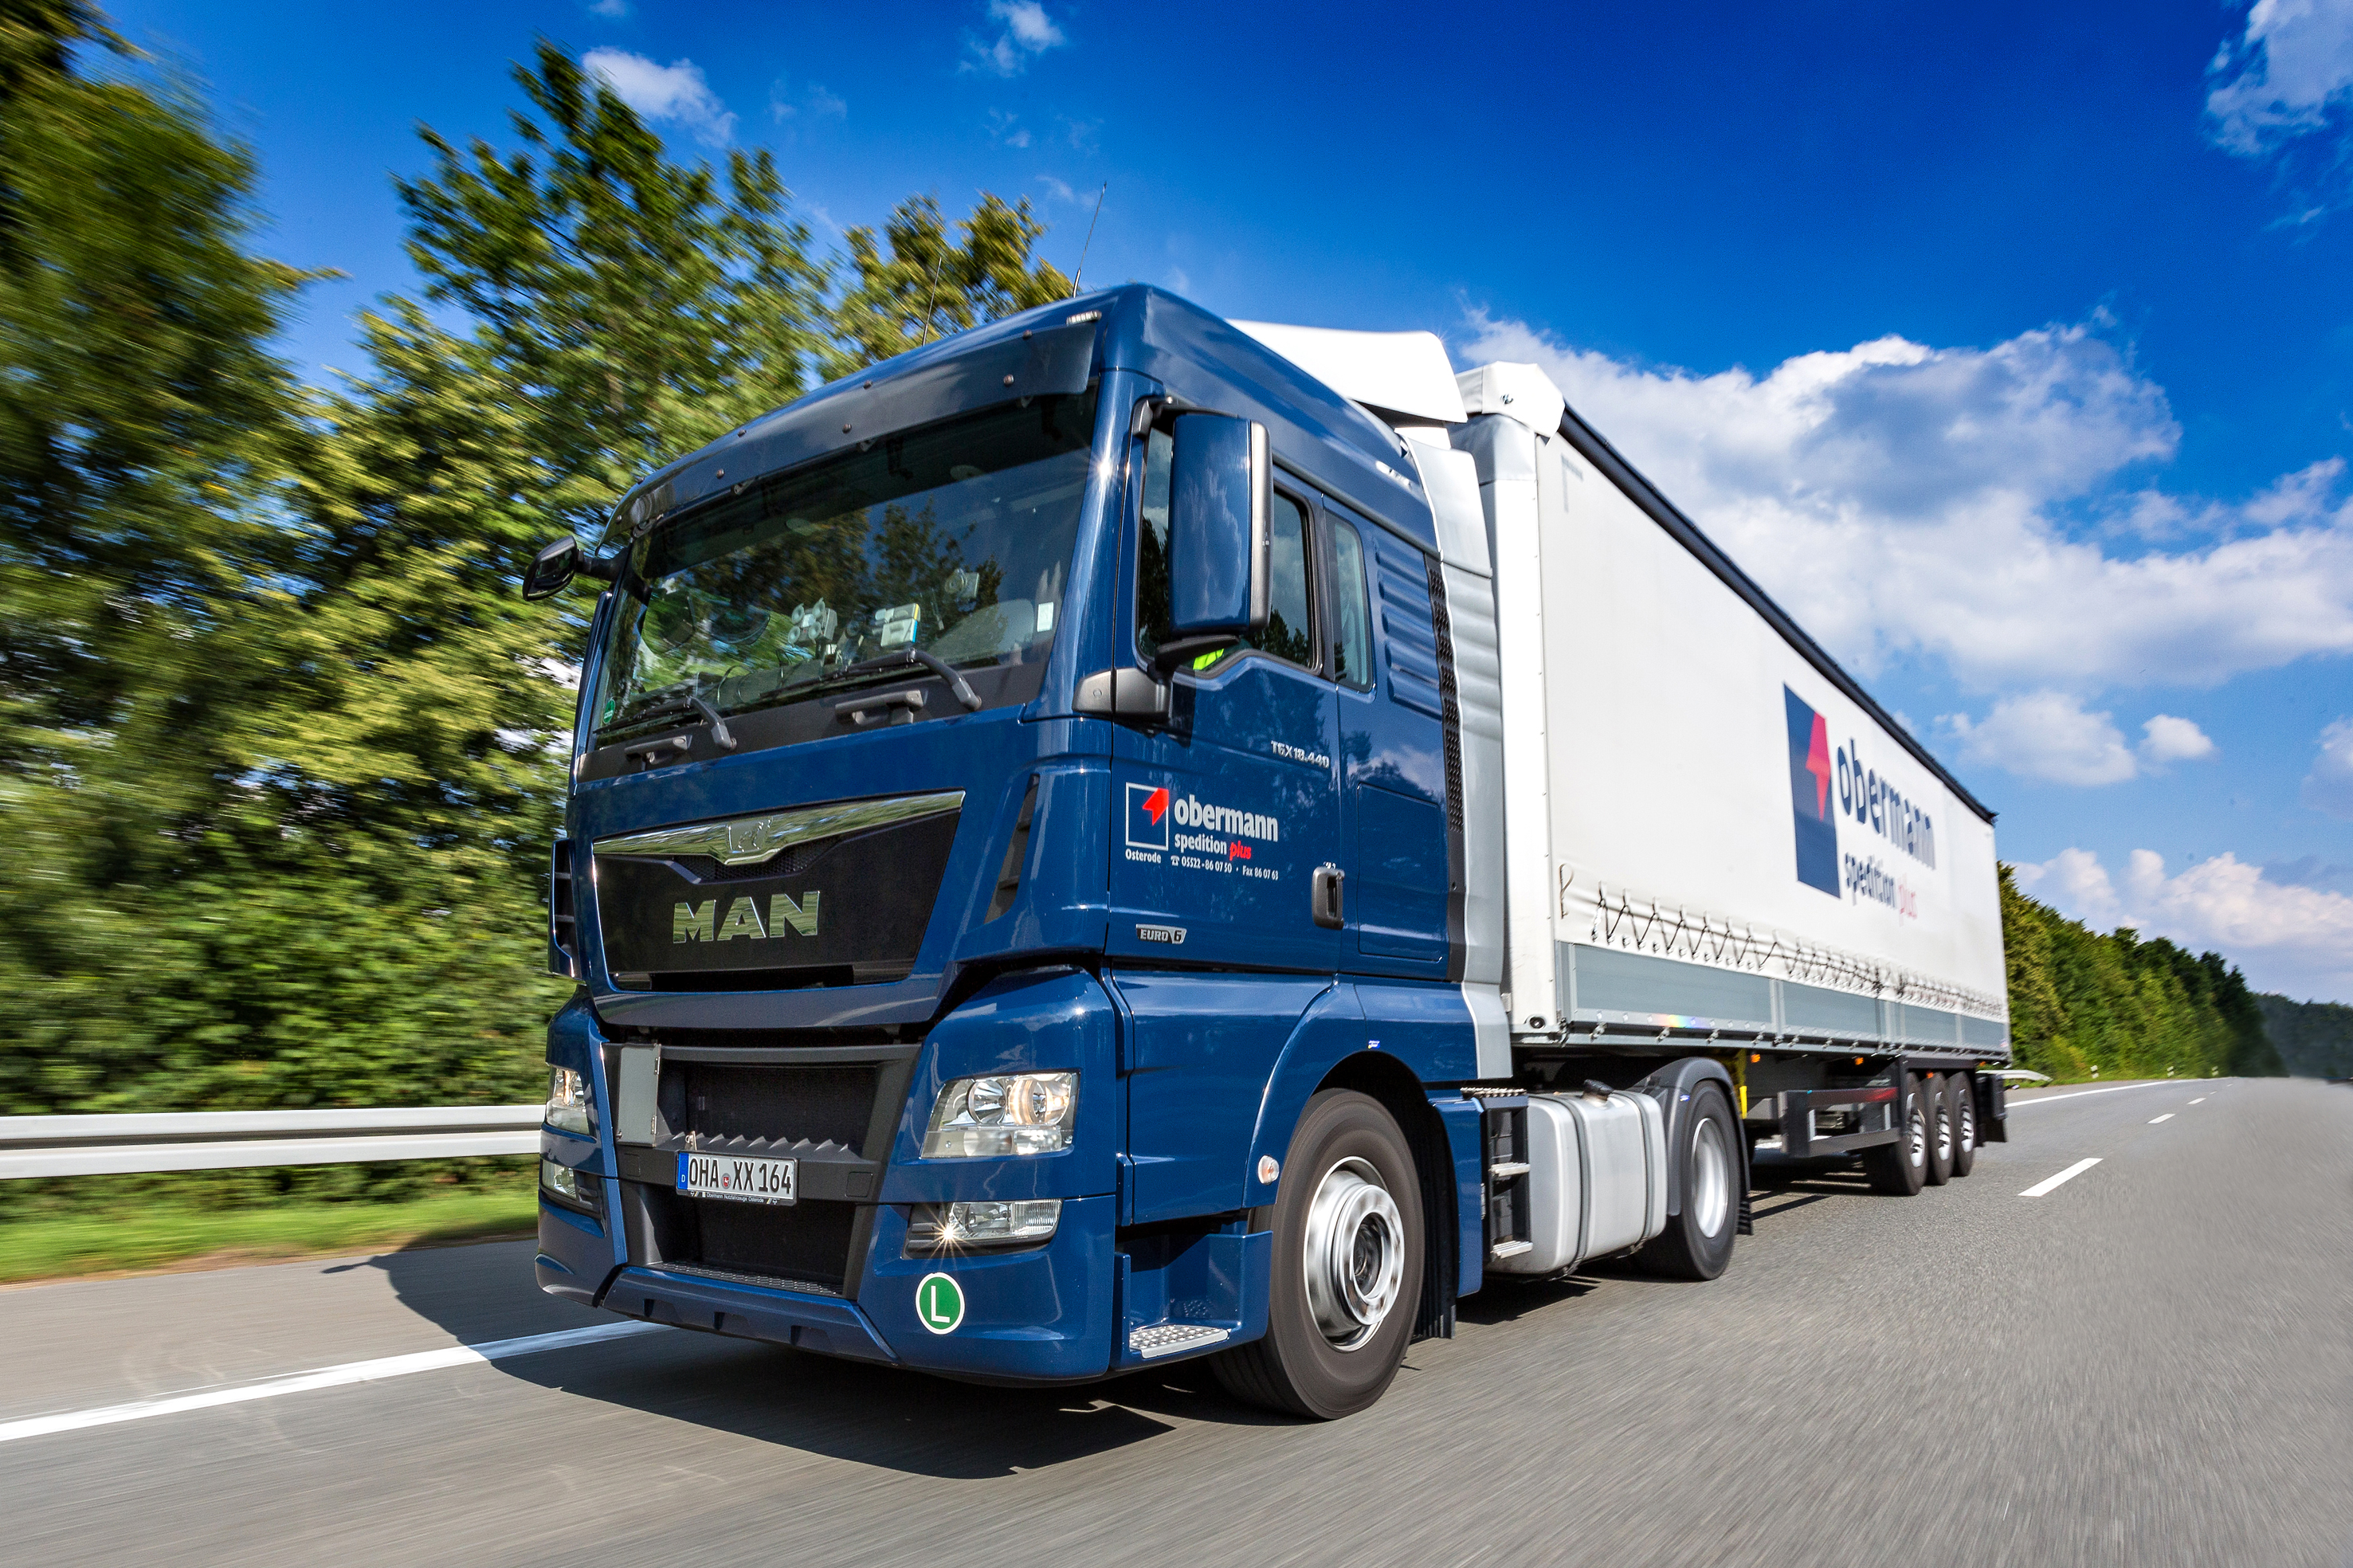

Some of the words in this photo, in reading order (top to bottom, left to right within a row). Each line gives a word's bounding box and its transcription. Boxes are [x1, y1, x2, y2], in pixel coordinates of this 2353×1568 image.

[1271, 740, 1292, 759] TGX
[1293, 747, 1330, 769] 18.440
[1175, 794, 1278, 842] obermann
[1837, 738, 1935, 869] obermann
[1125, 849, 1161, 864] Osterode
[1175, 833, 1227, 855] spedition
[1229, 841, 1252, 860] plus
[1242, 865, 1253, 876] Fax
[1254, 867, 1262, 878] 86
[1263, 868, 1271, 880] 07
[1845, 853, 1896, 908] spedition
[673, 891, 820, 944] MAN
[1140, 928, 1169, 942] EURO
[1174, 929, 1182, 942] 6
[689, 1158, 720, 1188] OHA
[732, 1161, 755, 1191] XX
[759, 1162, 792, 1194] 164
[931, 1285, 951, 1323] L
